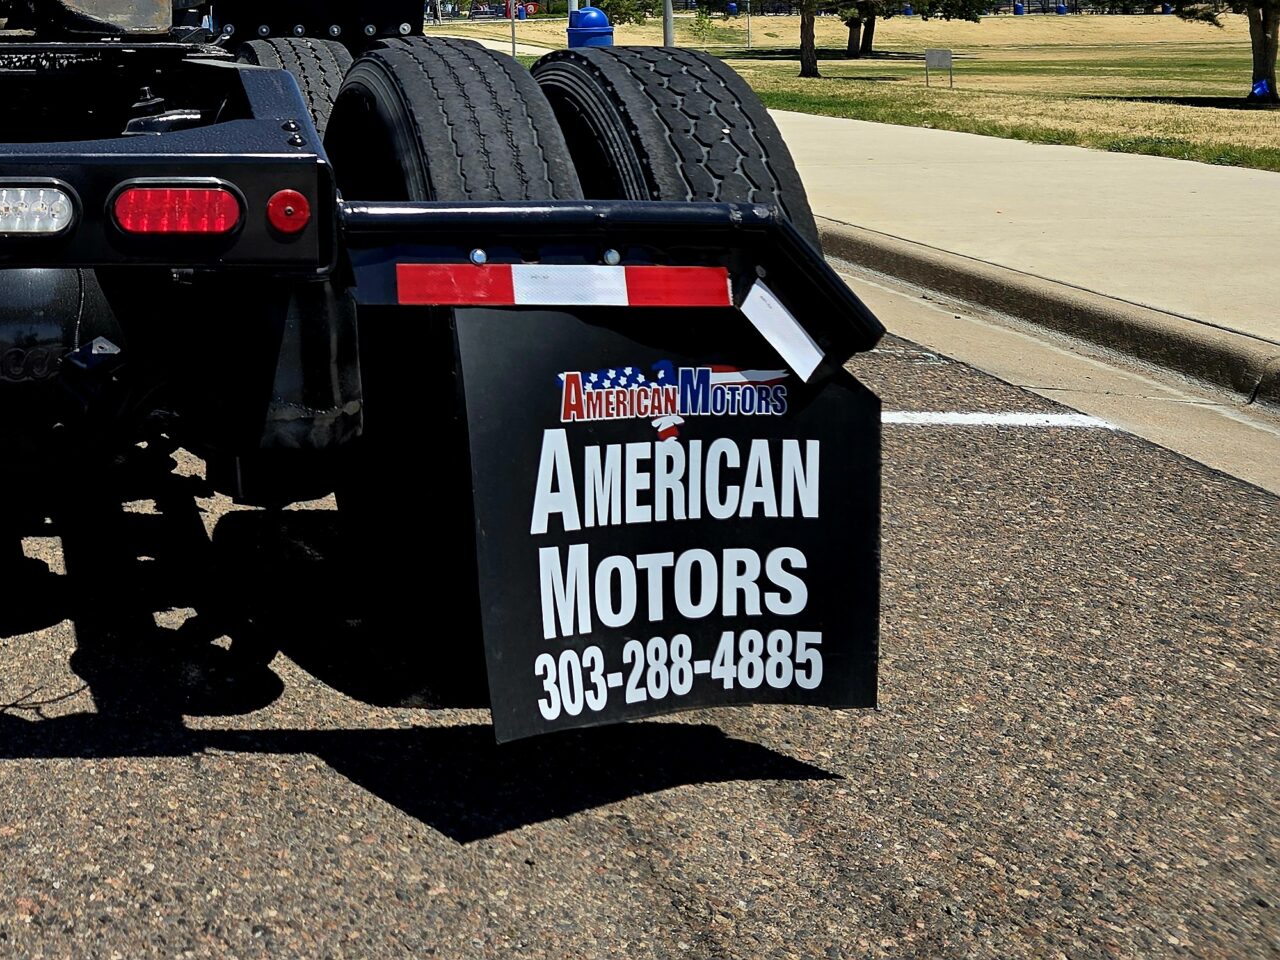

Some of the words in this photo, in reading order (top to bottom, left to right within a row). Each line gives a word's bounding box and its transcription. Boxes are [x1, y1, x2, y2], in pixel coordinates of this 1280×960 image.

[560, 371, 679, 422] AMERICAN
[678, 367, 788, 415] MOTORS
[530, 428, 820, 534] AMERICAN
[539, 543, 808, 639] MOTORS
[534, 630, 823, 722] 303-288-4885
